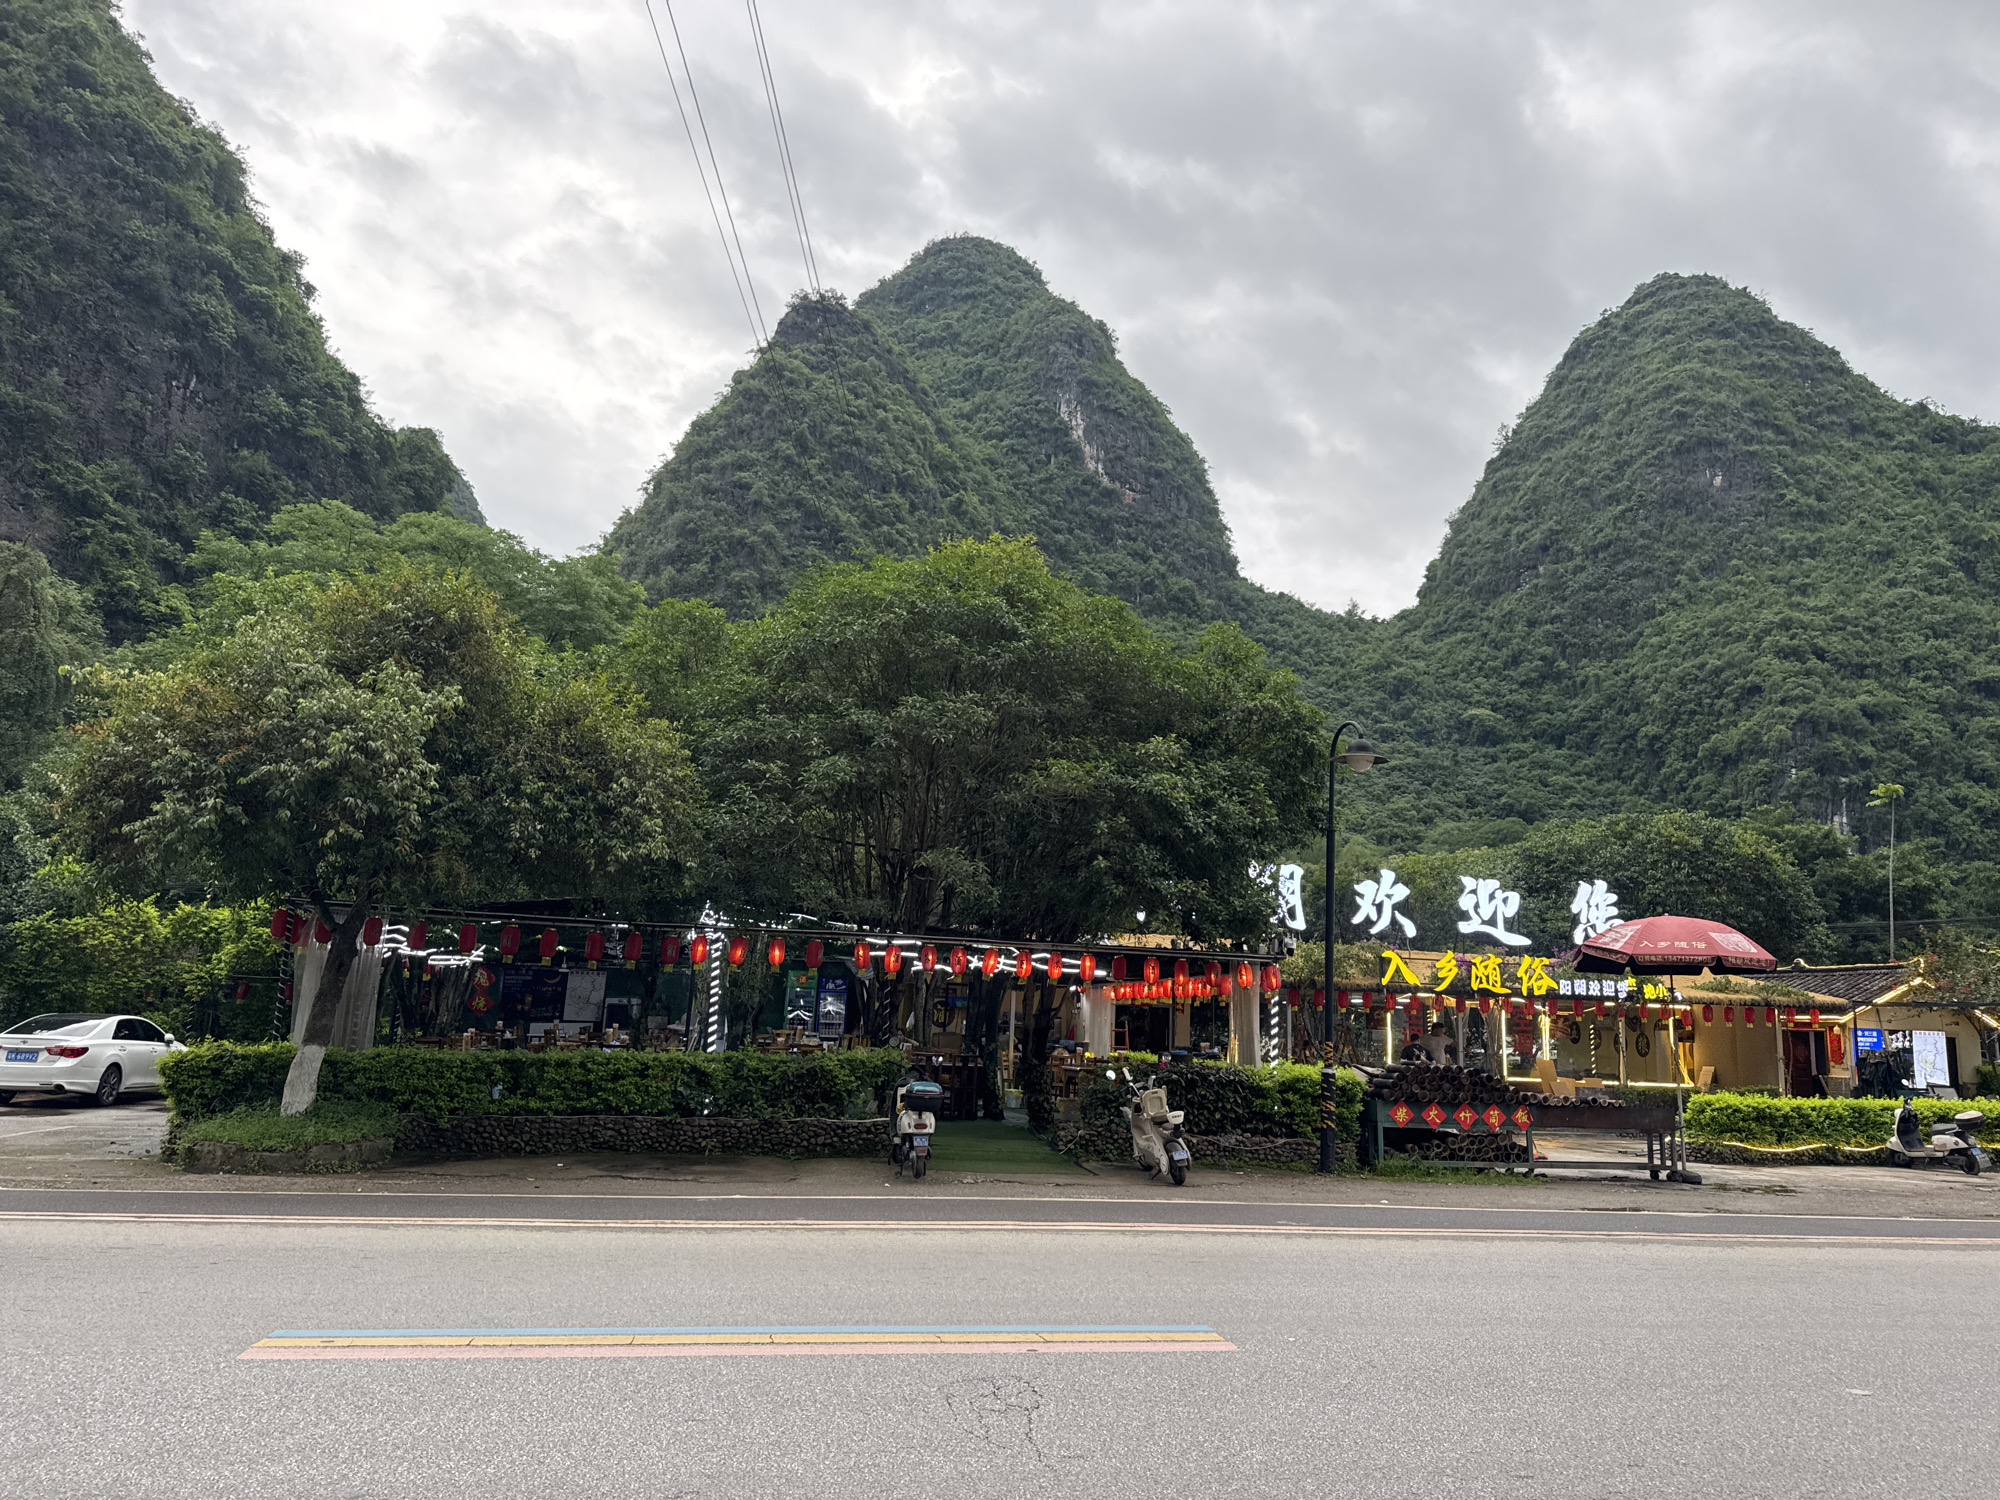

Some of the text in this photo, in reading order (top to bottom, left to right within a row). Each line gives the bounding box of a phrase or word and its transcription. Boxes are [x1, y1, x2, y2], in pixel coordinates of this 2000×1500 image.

[1381, 950, 1558, 996] 入乡随俗
[1395, 1106, 1530, 1127] 柴火竹筒饭
